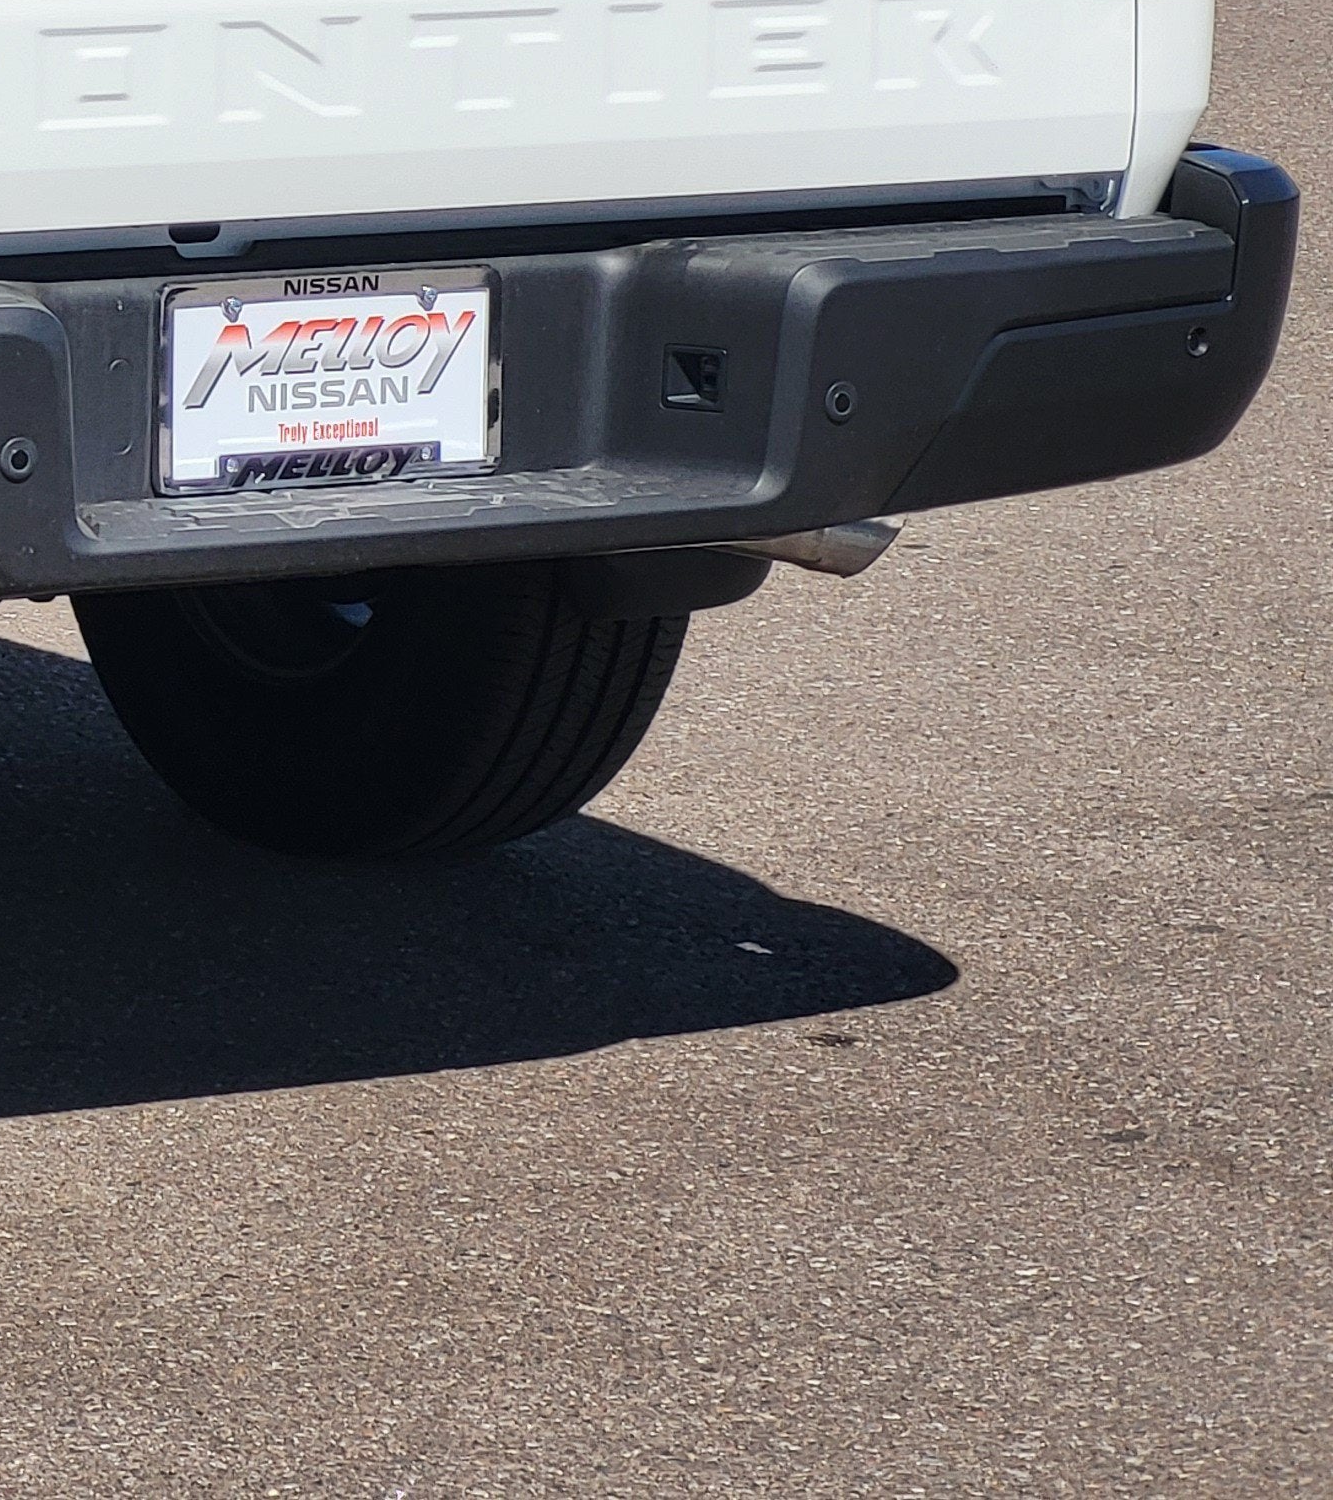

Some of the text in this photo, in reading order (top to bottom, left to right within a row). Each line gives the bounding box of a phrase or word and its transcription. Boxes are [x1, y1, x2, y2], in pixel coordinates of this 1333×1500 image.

[283, 274, 380, 296] NISSAN
[183, 310, 477, 410] MELLOY
[248, 376, 409, 413] NISSAN
[278, 418, 379, 444] Truly Exceptional
[236, 446, 411, 486] MELLOY
